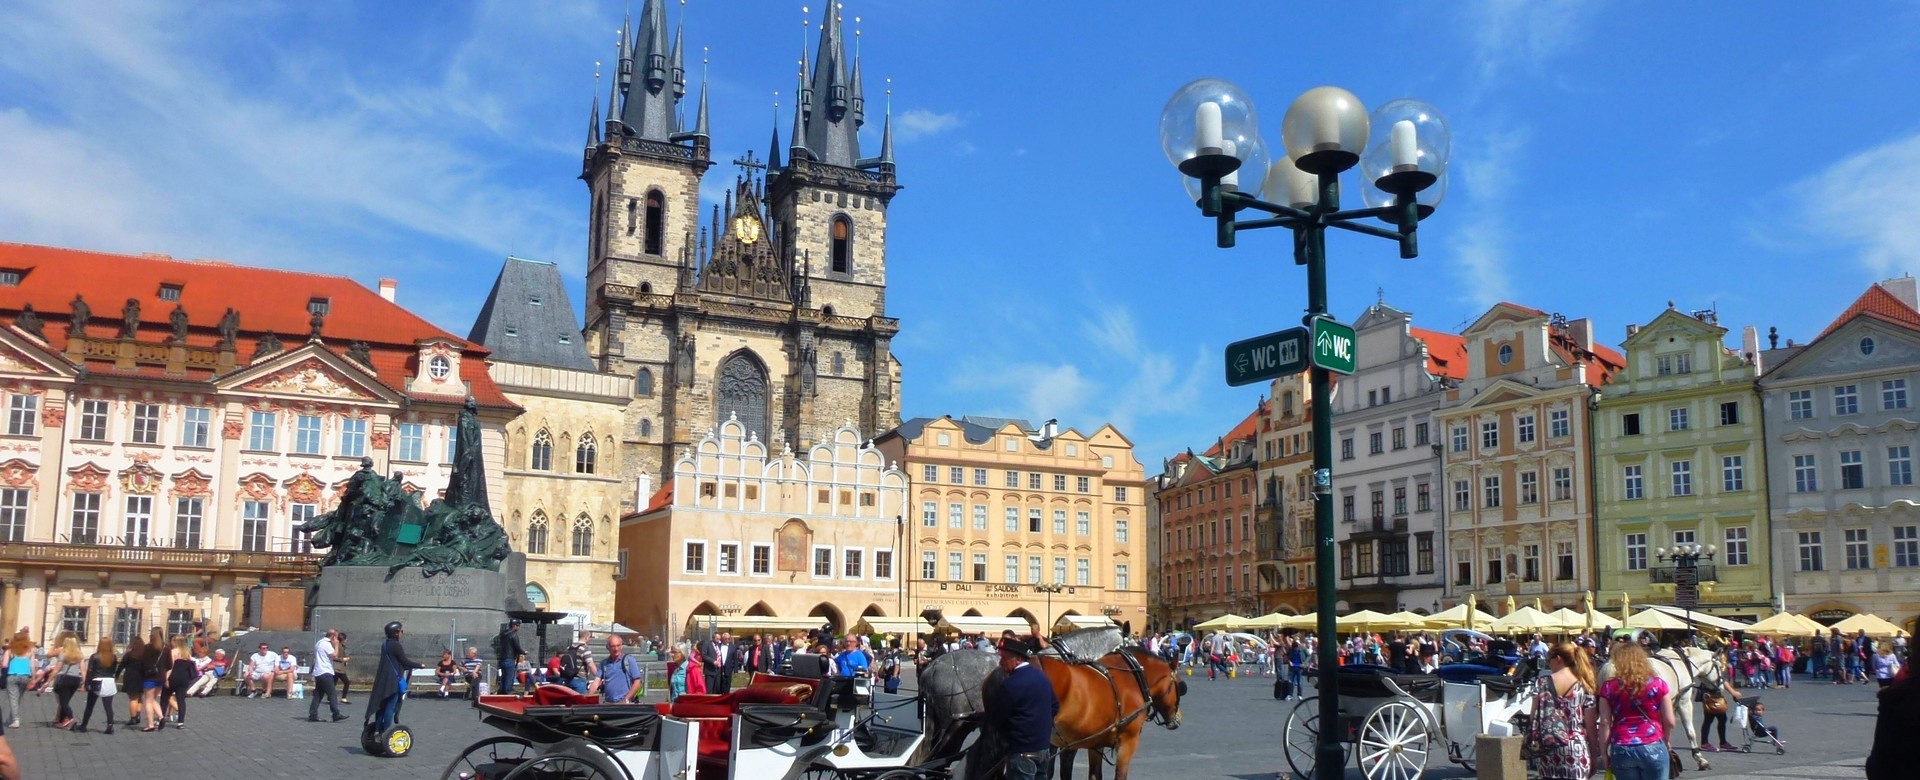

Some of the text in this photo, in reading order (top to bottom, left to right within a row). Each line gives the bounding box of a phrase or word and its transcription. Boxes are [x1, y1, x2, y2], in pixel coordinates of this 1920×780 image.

[1333, 334, 1351, 362] WC
[1251, 345, 1276, 371] WC
[59, 533, 133, 546] NODN
[994, 584, 1019, 593] SAUDEK
